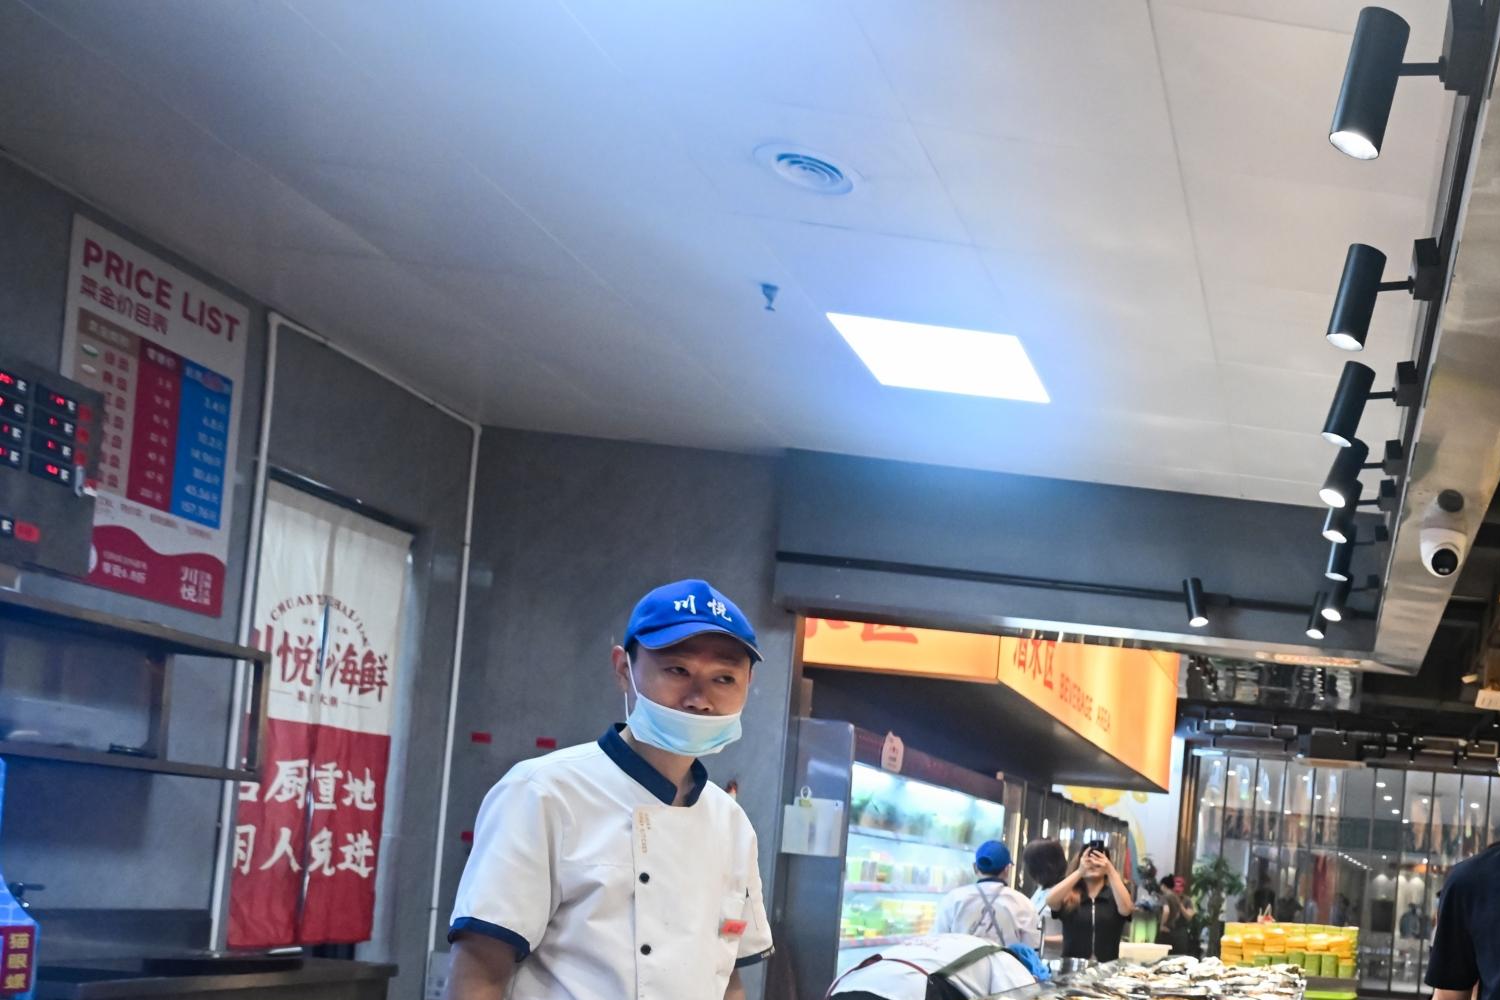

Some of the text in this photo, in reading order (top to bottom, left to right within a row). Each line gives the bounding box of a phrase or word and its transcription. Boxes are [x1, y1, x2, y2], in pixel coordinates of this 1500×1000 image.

[83, 237, 173, 311] PRICE
[181, 291, 241, 342] LIST
[1060, 671, 1093, 722] BEVERAGE
